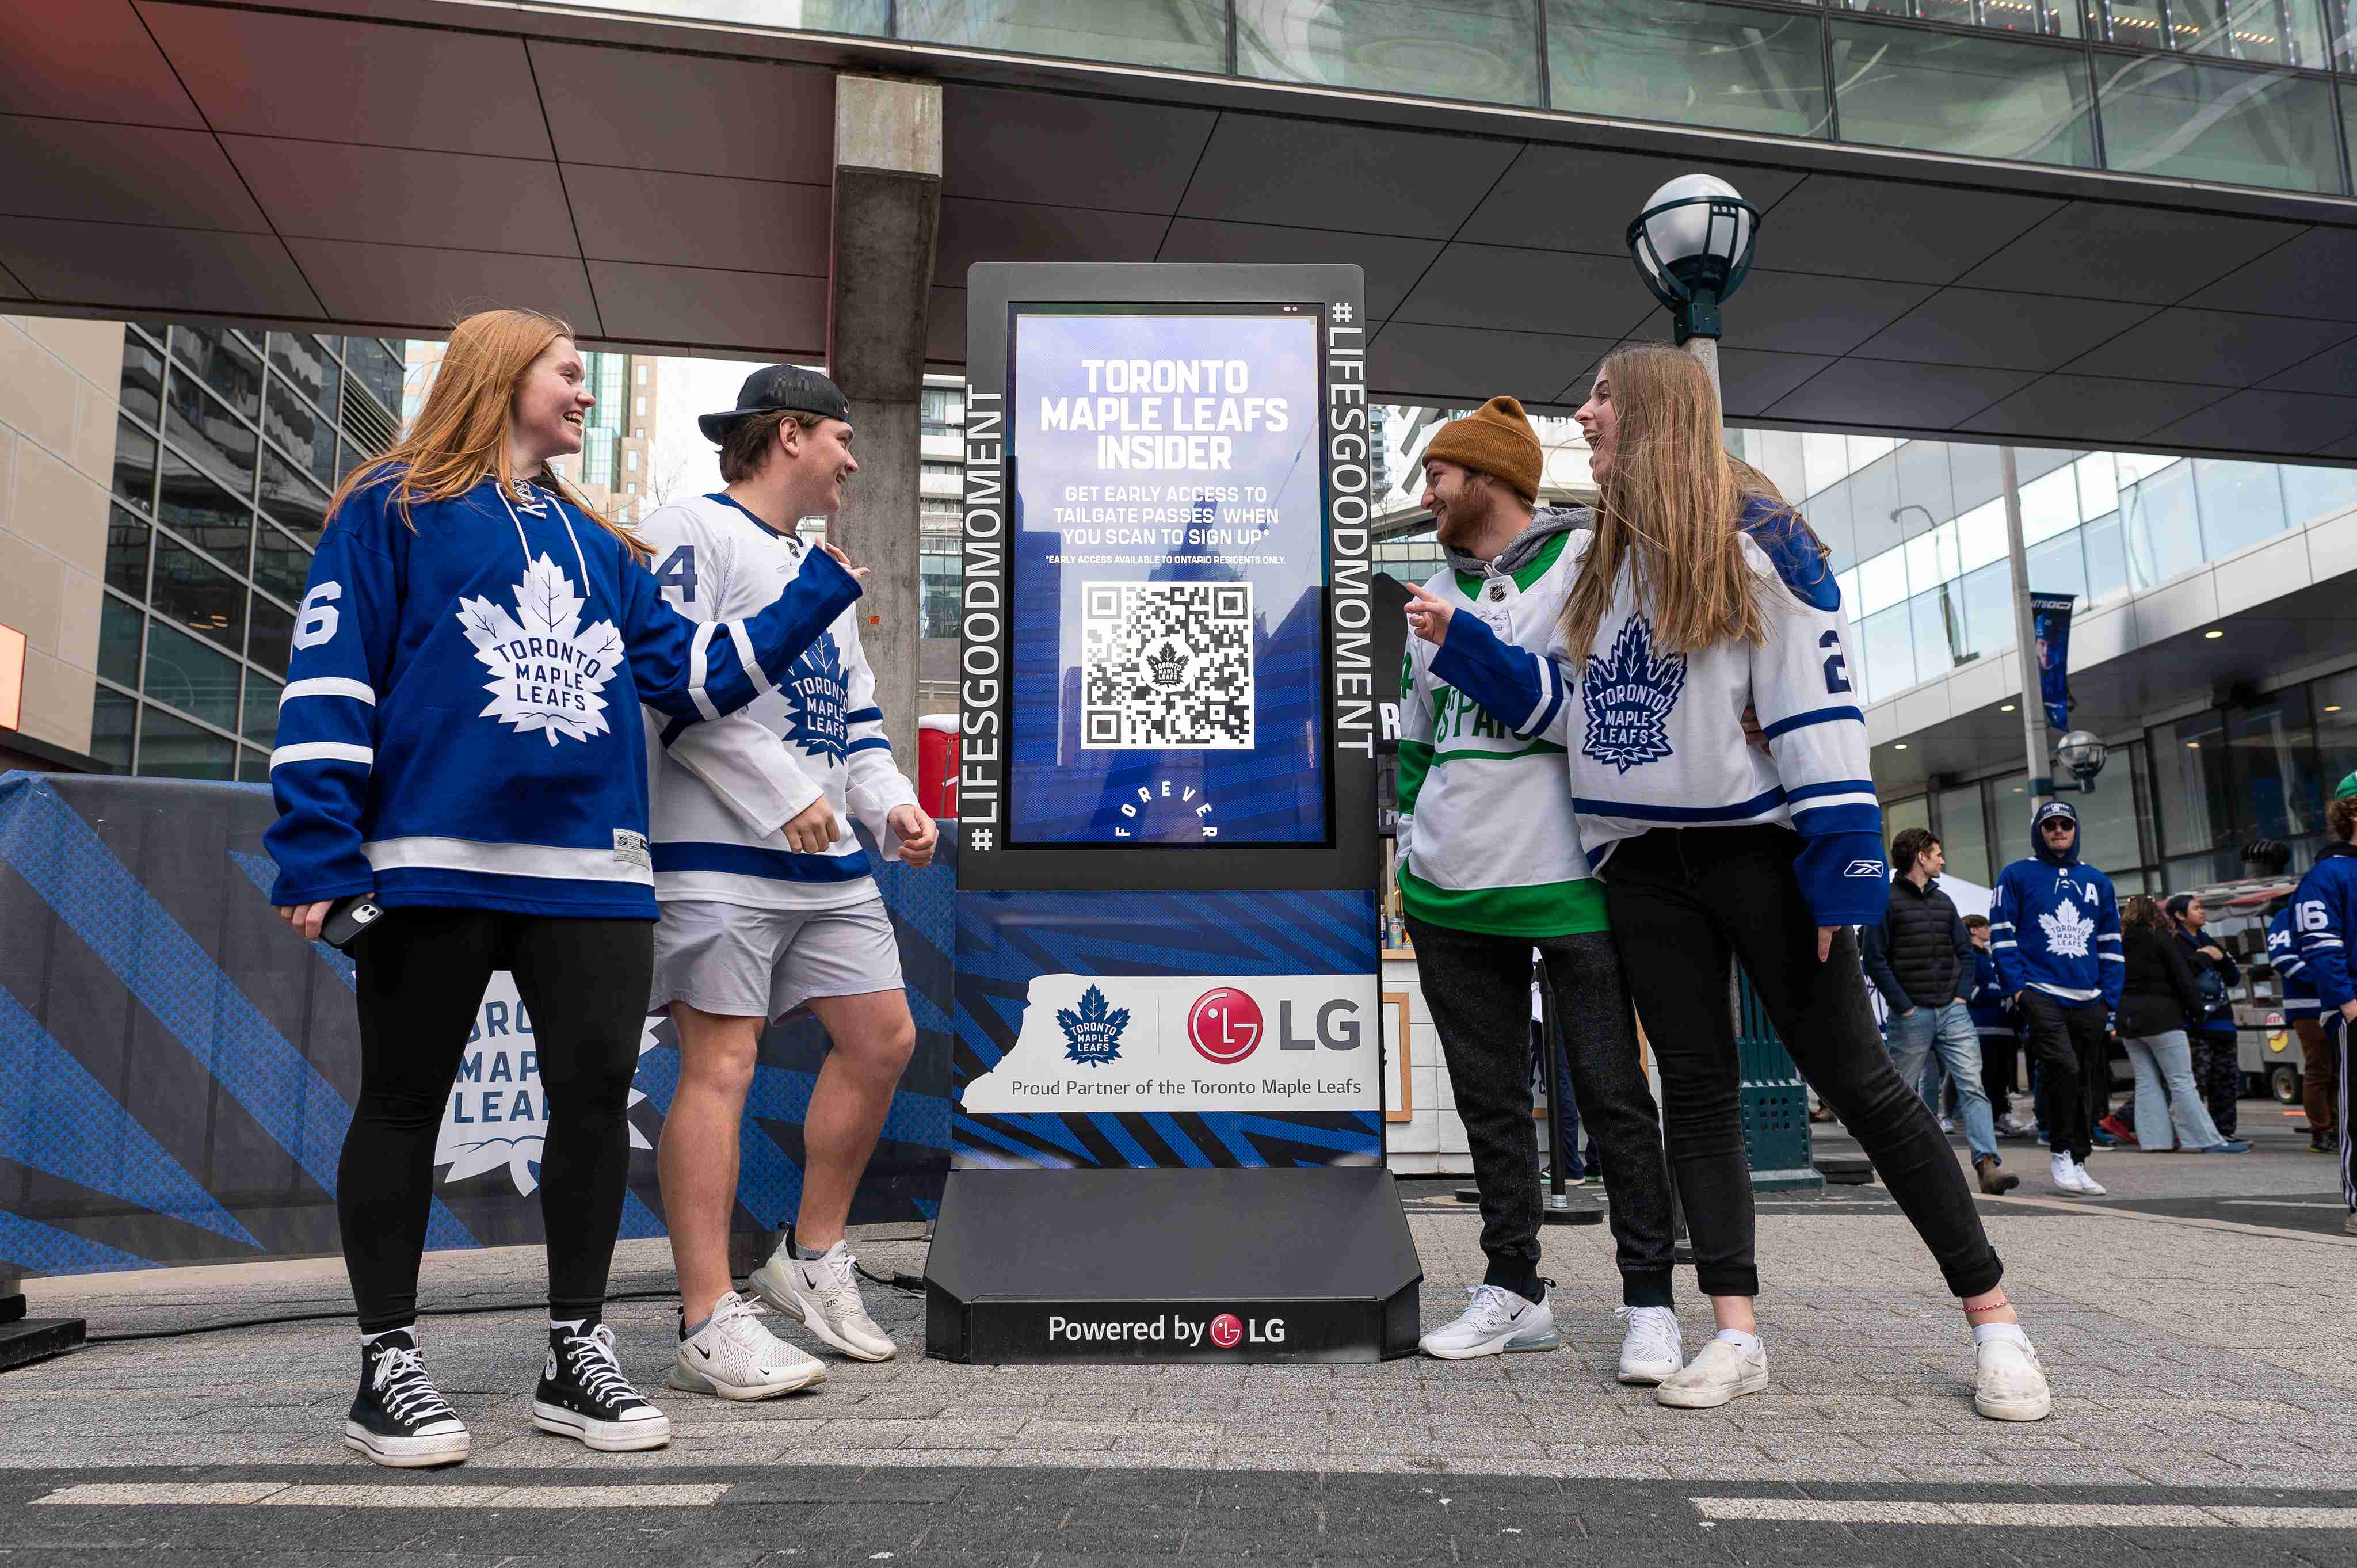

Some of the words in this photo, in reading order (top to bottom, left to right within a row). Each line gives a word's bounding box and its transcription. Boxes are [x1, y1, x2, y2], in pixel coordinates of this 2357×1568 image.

[1082, 360, 1248, 393] TORONTO
[1042, 397, 1162, 431] MAPLE
[1174, 398, 1288, 432] LEAFS
[1097, 435, 1231, 470] INSIDER
[1066, 486, 1099, 502] GET
[1105, 486, 1161, 502] EARLY
[1166, 486, 1238, 502] ACCESS
[1245, 487, 1266, 502] TO
[1054, 508, 1137, 523] TAILGATE
[1143, 508, 1214, 523] PASSES
[1223, 509, 1278, 524] WHEN
[1063, 529, 1100, 544] YOU
[1106, 529, 1155, 544] SCAN
[1161, 529, 1183, 544] TO
[1189, 529, 1231, 544] SIGN
[1329, 302, 1374, 758] #LIFESGOODMOMENT
[1078, 556, 1112, 564] ACCESS
[1114, 556, 1159, 564] AVAILABLE
[1161, 556, 1172, 564] TO
[1174, 556, 1212, 564] ONTARIO
[1214, 556, 1260, 564] RESIDENTS
[1263, 556, 1286, 564] ONLY.
[962, 384, 1002, 851] #LIFESGOODMOMENT
[493, 638, 601, 678] TORONTO
[1154, 662, 1182, 671] TORONTO
[516, 663, 585, 690] MAPLE
[517, 689, 585, 711] LEAFS
[791, 677, 847, 713] TORONTO
[1595, 684, 1665, 711] TORONTO
[807, 697, 845, 723] MAPLE
[1605, 710, 1650, 727] MAPLE
[807, 715, 844, 740] LEAFS
[1600, 727, 1649, 745] LEAFS
[1115, 781, 1218, 837] FOREVER
[2084, 883, 2099, 906] A
[2295, 900, 2329, 933] 16
[2051, 925, 2086, 937] TORONTO
[2057, 933, 2081, 941] MAPLE
[2057, 940, 2081, 948] LEAFS
[1070, 1022, 1117, 1036] TORONTO
[1280, 999, 1361, 1051] LG
[1078, 1034, 1109, 1042] MAPLE
[1078, 1043, 1109, 1051] LEAFS
[1012, 1081, 1060, 1095] Proud
[1067, 1081, 1131, 1095] Partner
[1136, 1079, 1153, 1094] of
[1158, 1079, 1185, 1094] the
[1191, 1079, 1256, 1094] Toronto
[1262, 1079, 1311, 1098] Maple
[1318, 1078, 1361, 1093] Leafs
[1049, 1315, 1165, 1340] Powered
[1174, 1314, 1205, 1347] by
[1249, 1318, 1286, 1342] LG
